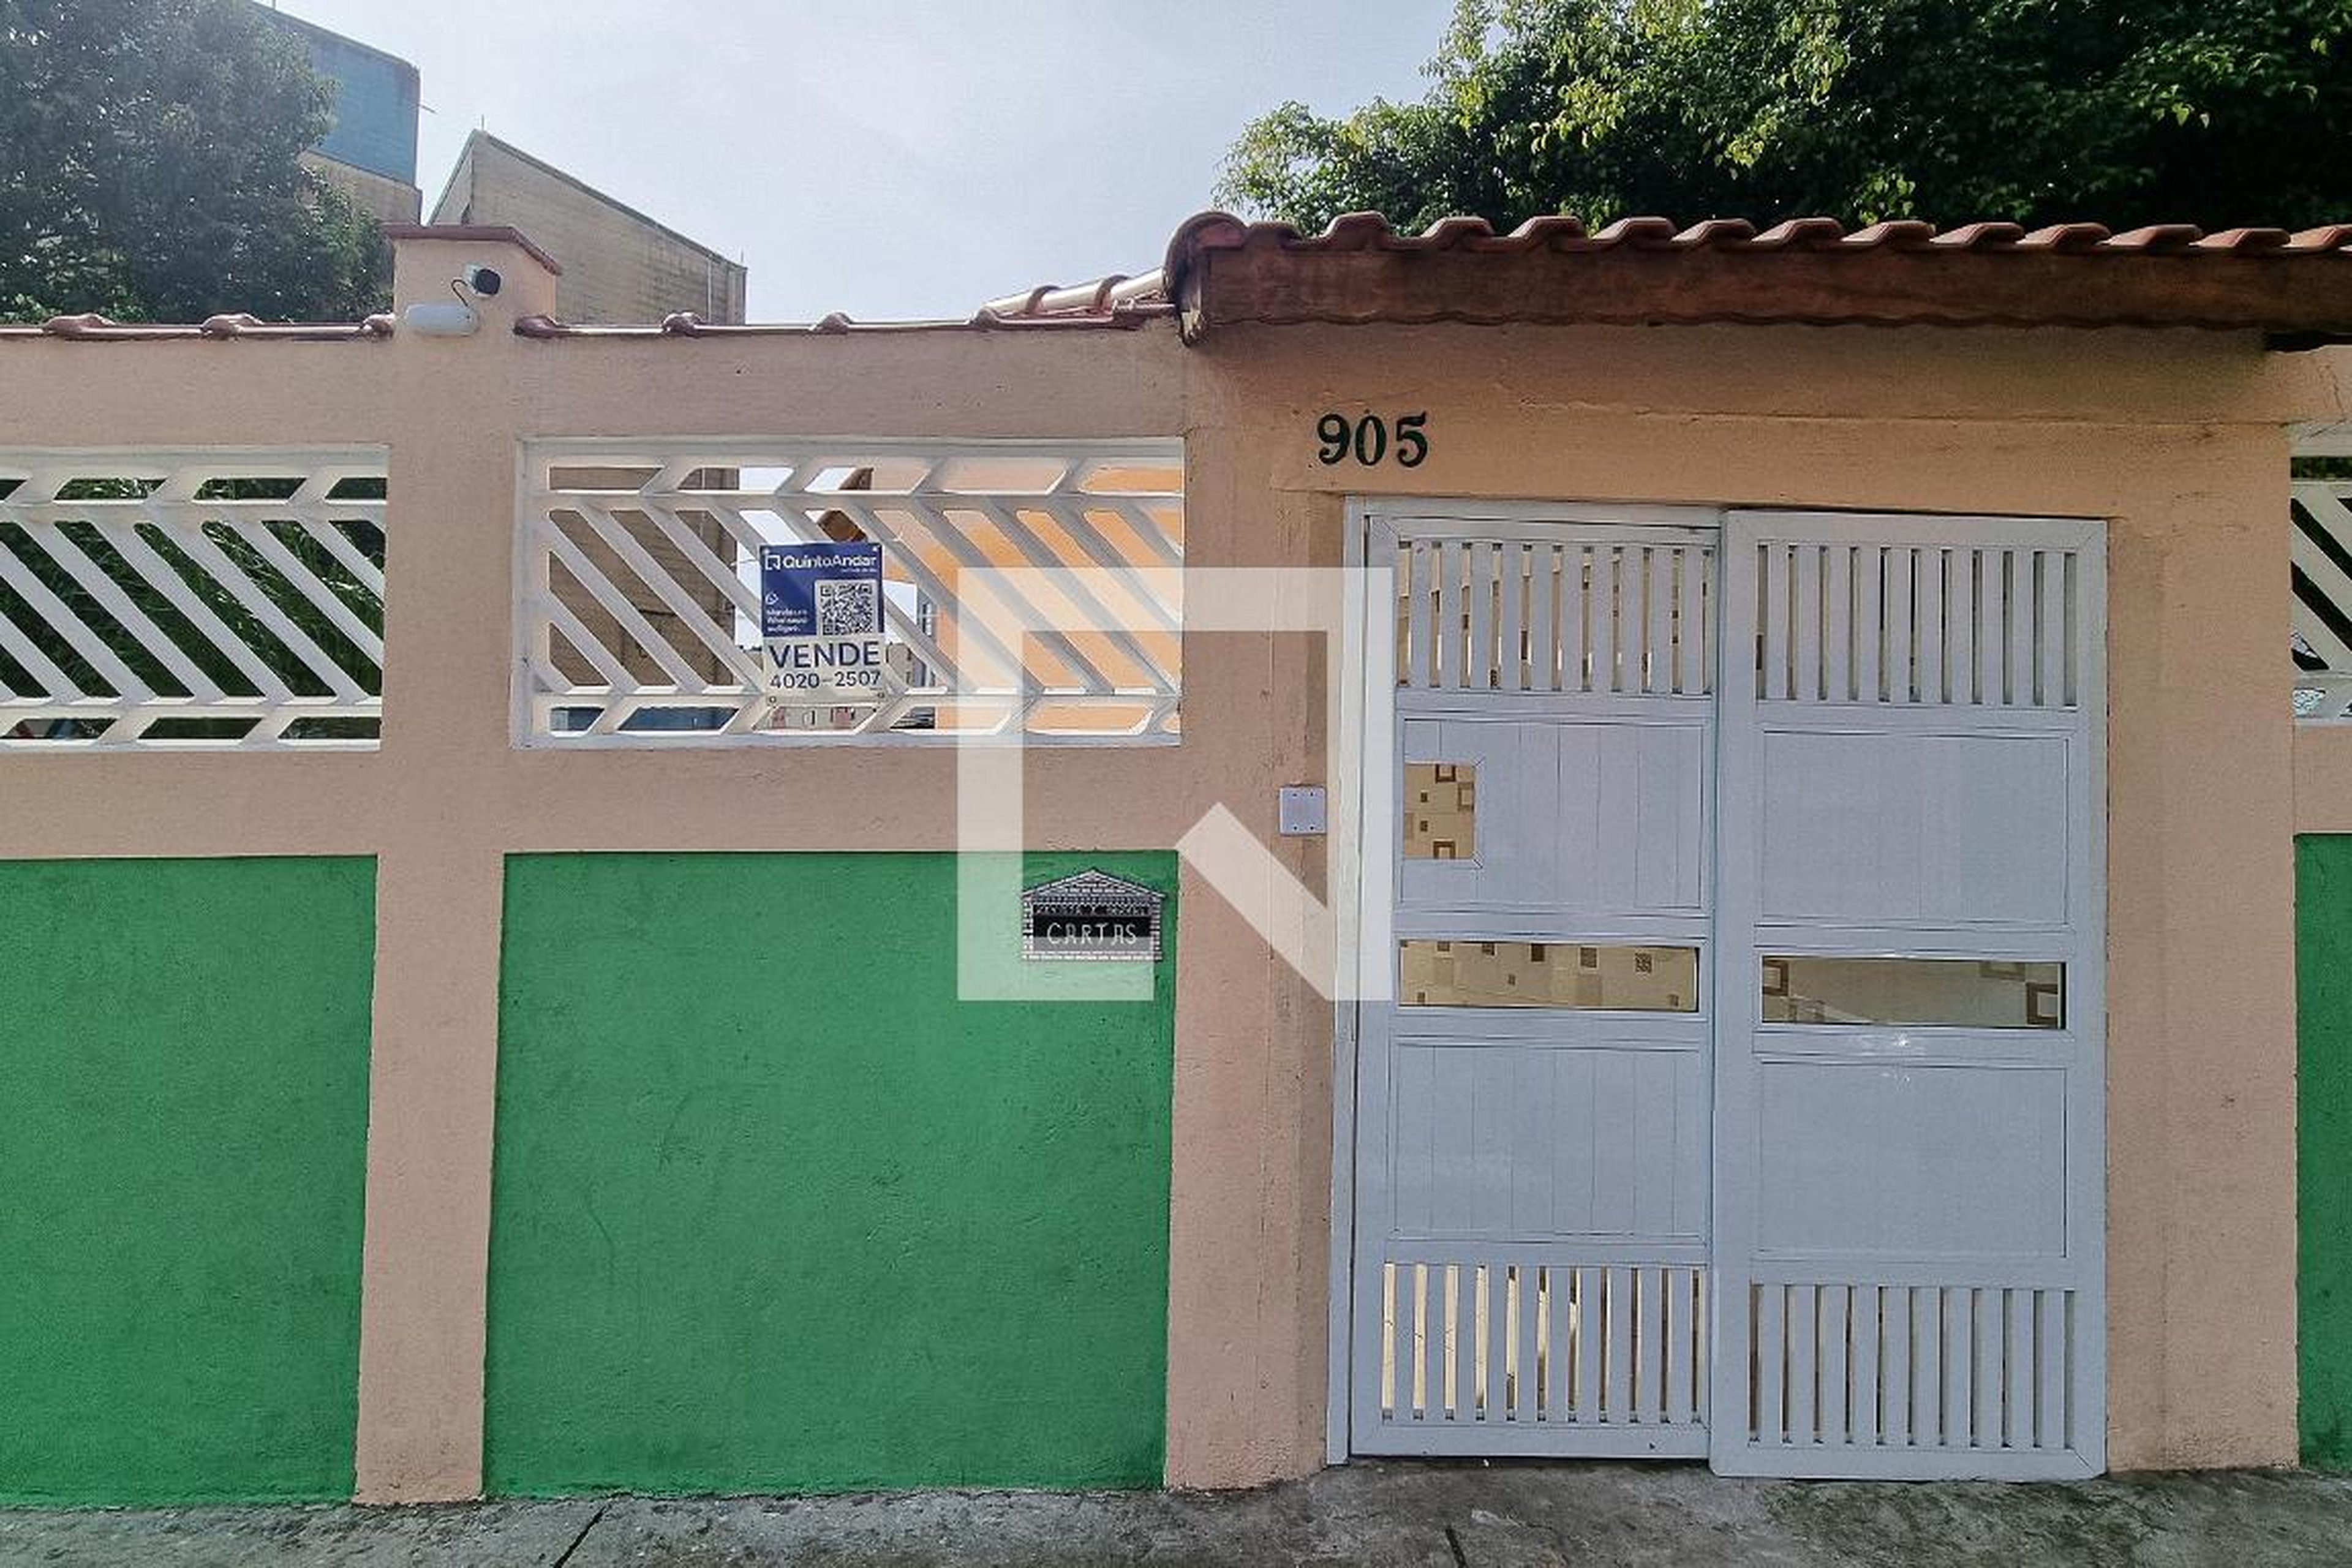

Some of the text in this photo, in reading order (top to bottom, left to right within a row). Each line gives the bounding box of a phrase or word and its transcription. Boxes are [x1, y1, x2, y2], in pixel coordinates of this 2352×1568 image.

[1317, 411, 1428, 467] 905
[782, 554, 877, 569] QuintoAndar
[768, 641, 881, 669] VENDE
[770, 670, 881, 688] 4020-2507
[1047, 922, 1137, 945] CARTAS
